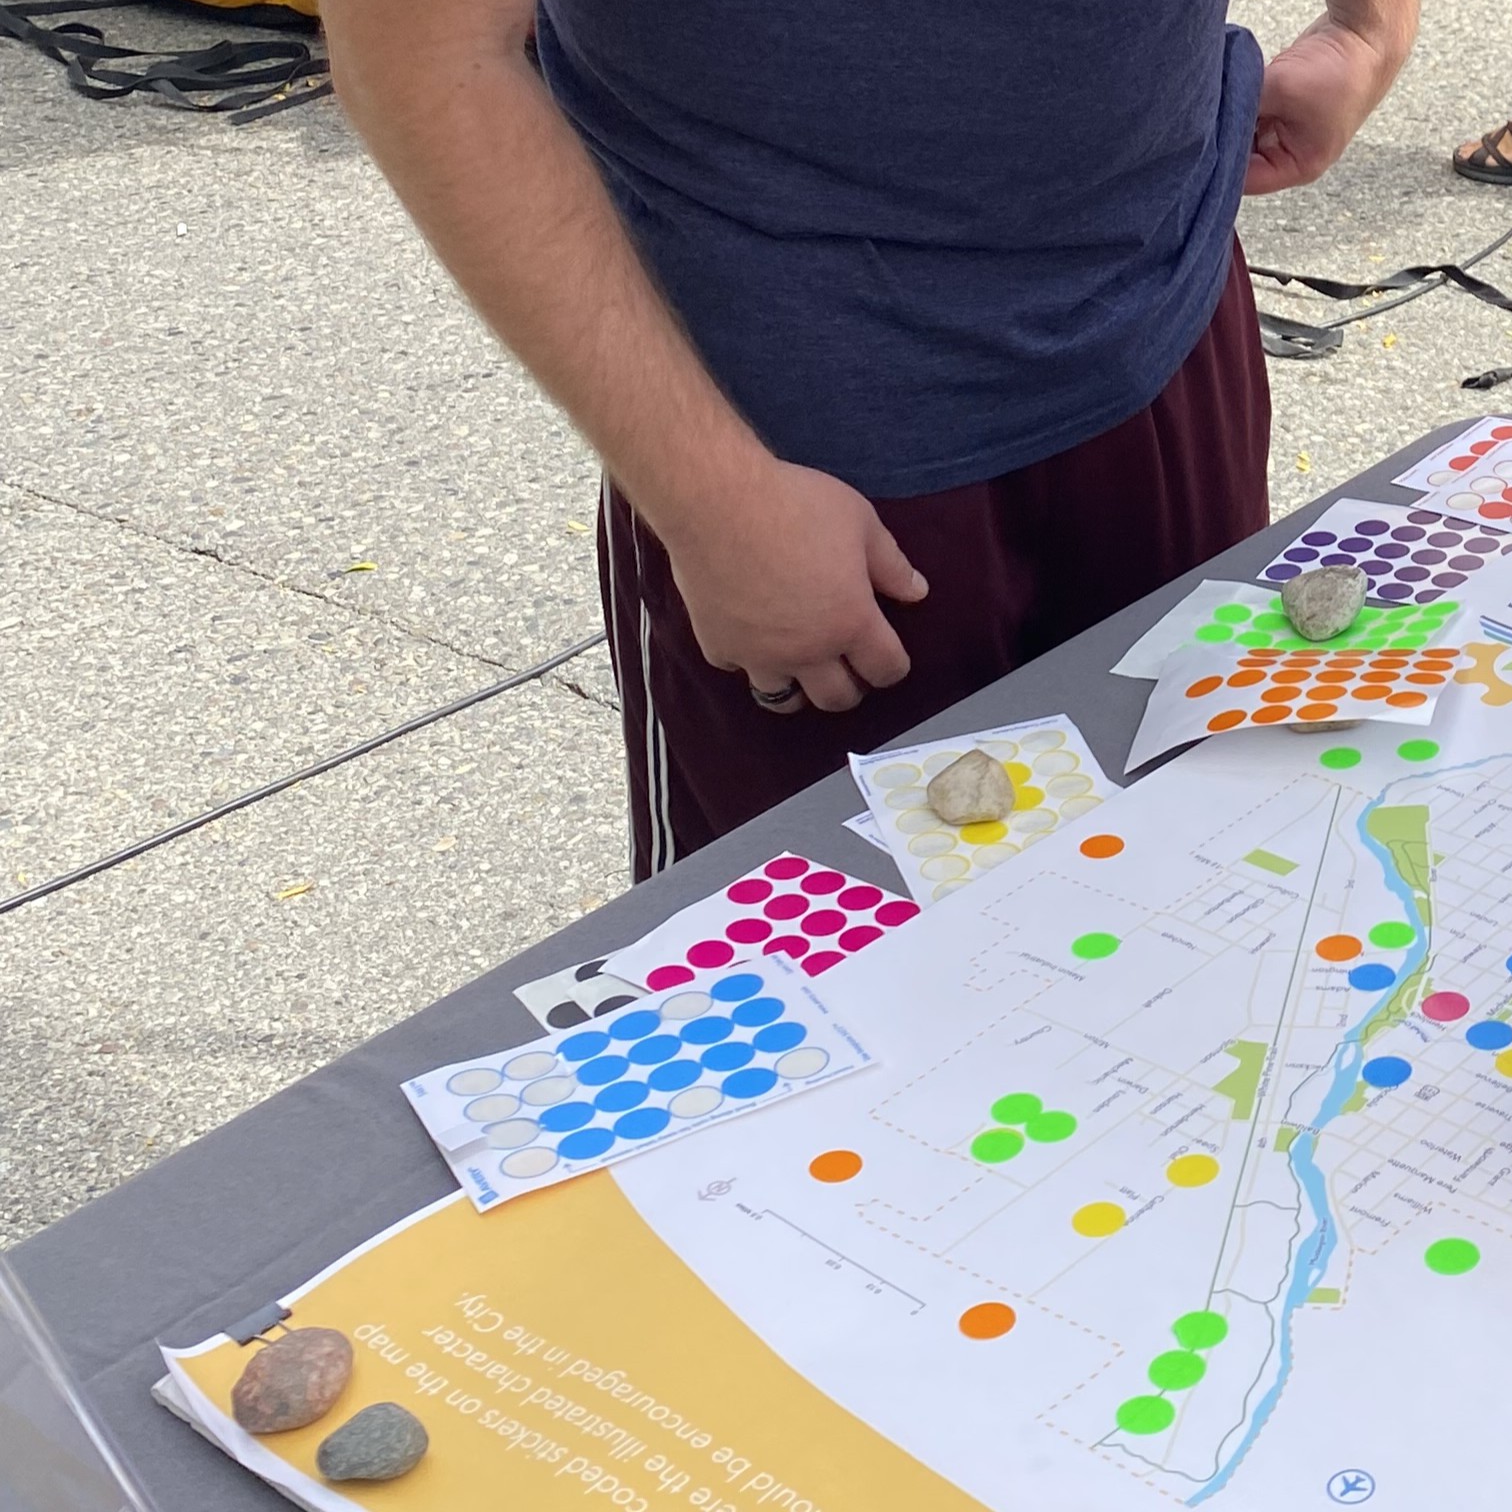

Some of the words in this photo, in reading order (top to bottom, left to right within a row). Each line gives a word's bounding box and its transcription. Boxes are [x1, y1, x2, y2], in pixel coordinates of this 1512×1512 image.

[1393, 1192, 1433, 1215] Williams
[453, 1289, 505, 1334] City.
[351, 1320, 410, 1364] map
[419, 1322, 533, 1398] character
[501, 1325, 544, 1358] the
[539, 1344, 570, 1373] in
[401, 1359, 450, 1397] the
[443, 1386, 481, 1415] on
[568, 1357, 714, 1452] encouraged
[476, 1408, 569, 1467] stickers
[525, 1385, 647, 1464] illustrated
[642, 1452, 691, 1494] the
[709, 1445, 752, 1483] be
[738, 1471, 818, 1512] ould
